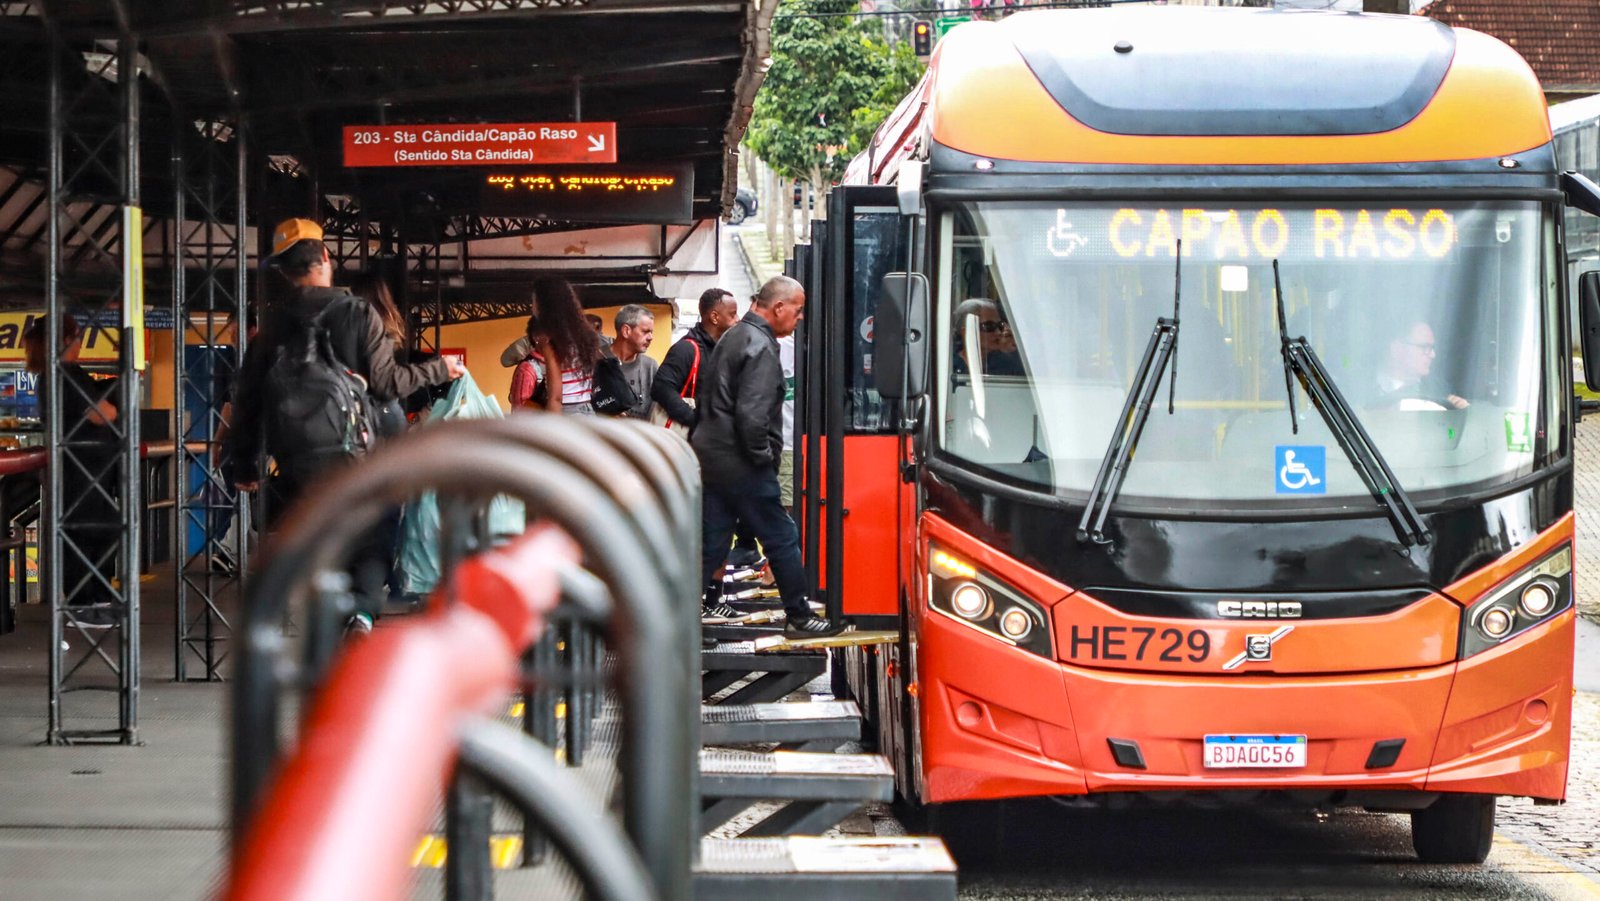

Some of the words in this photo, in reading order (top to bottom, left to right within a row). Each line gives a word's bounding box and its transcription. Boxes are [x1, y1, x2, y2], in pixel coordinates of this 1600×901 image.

[353, 131, 381, 144] 203
[393, 131, 417, 144] Sta
[422, 128, 536, 144] Cândida/Capão
[540, 127, 578, 140] Raso
[394, 149, 448, 163] (Sentido
[451, 149, 473, 160] Sta
[475, 148, 534, 162] Cândida)
[1314, 208, 1454, 258] RASO
[1217, 601, 1302, 617] CAIO
[1070, 625, 1211, 663] HE729
